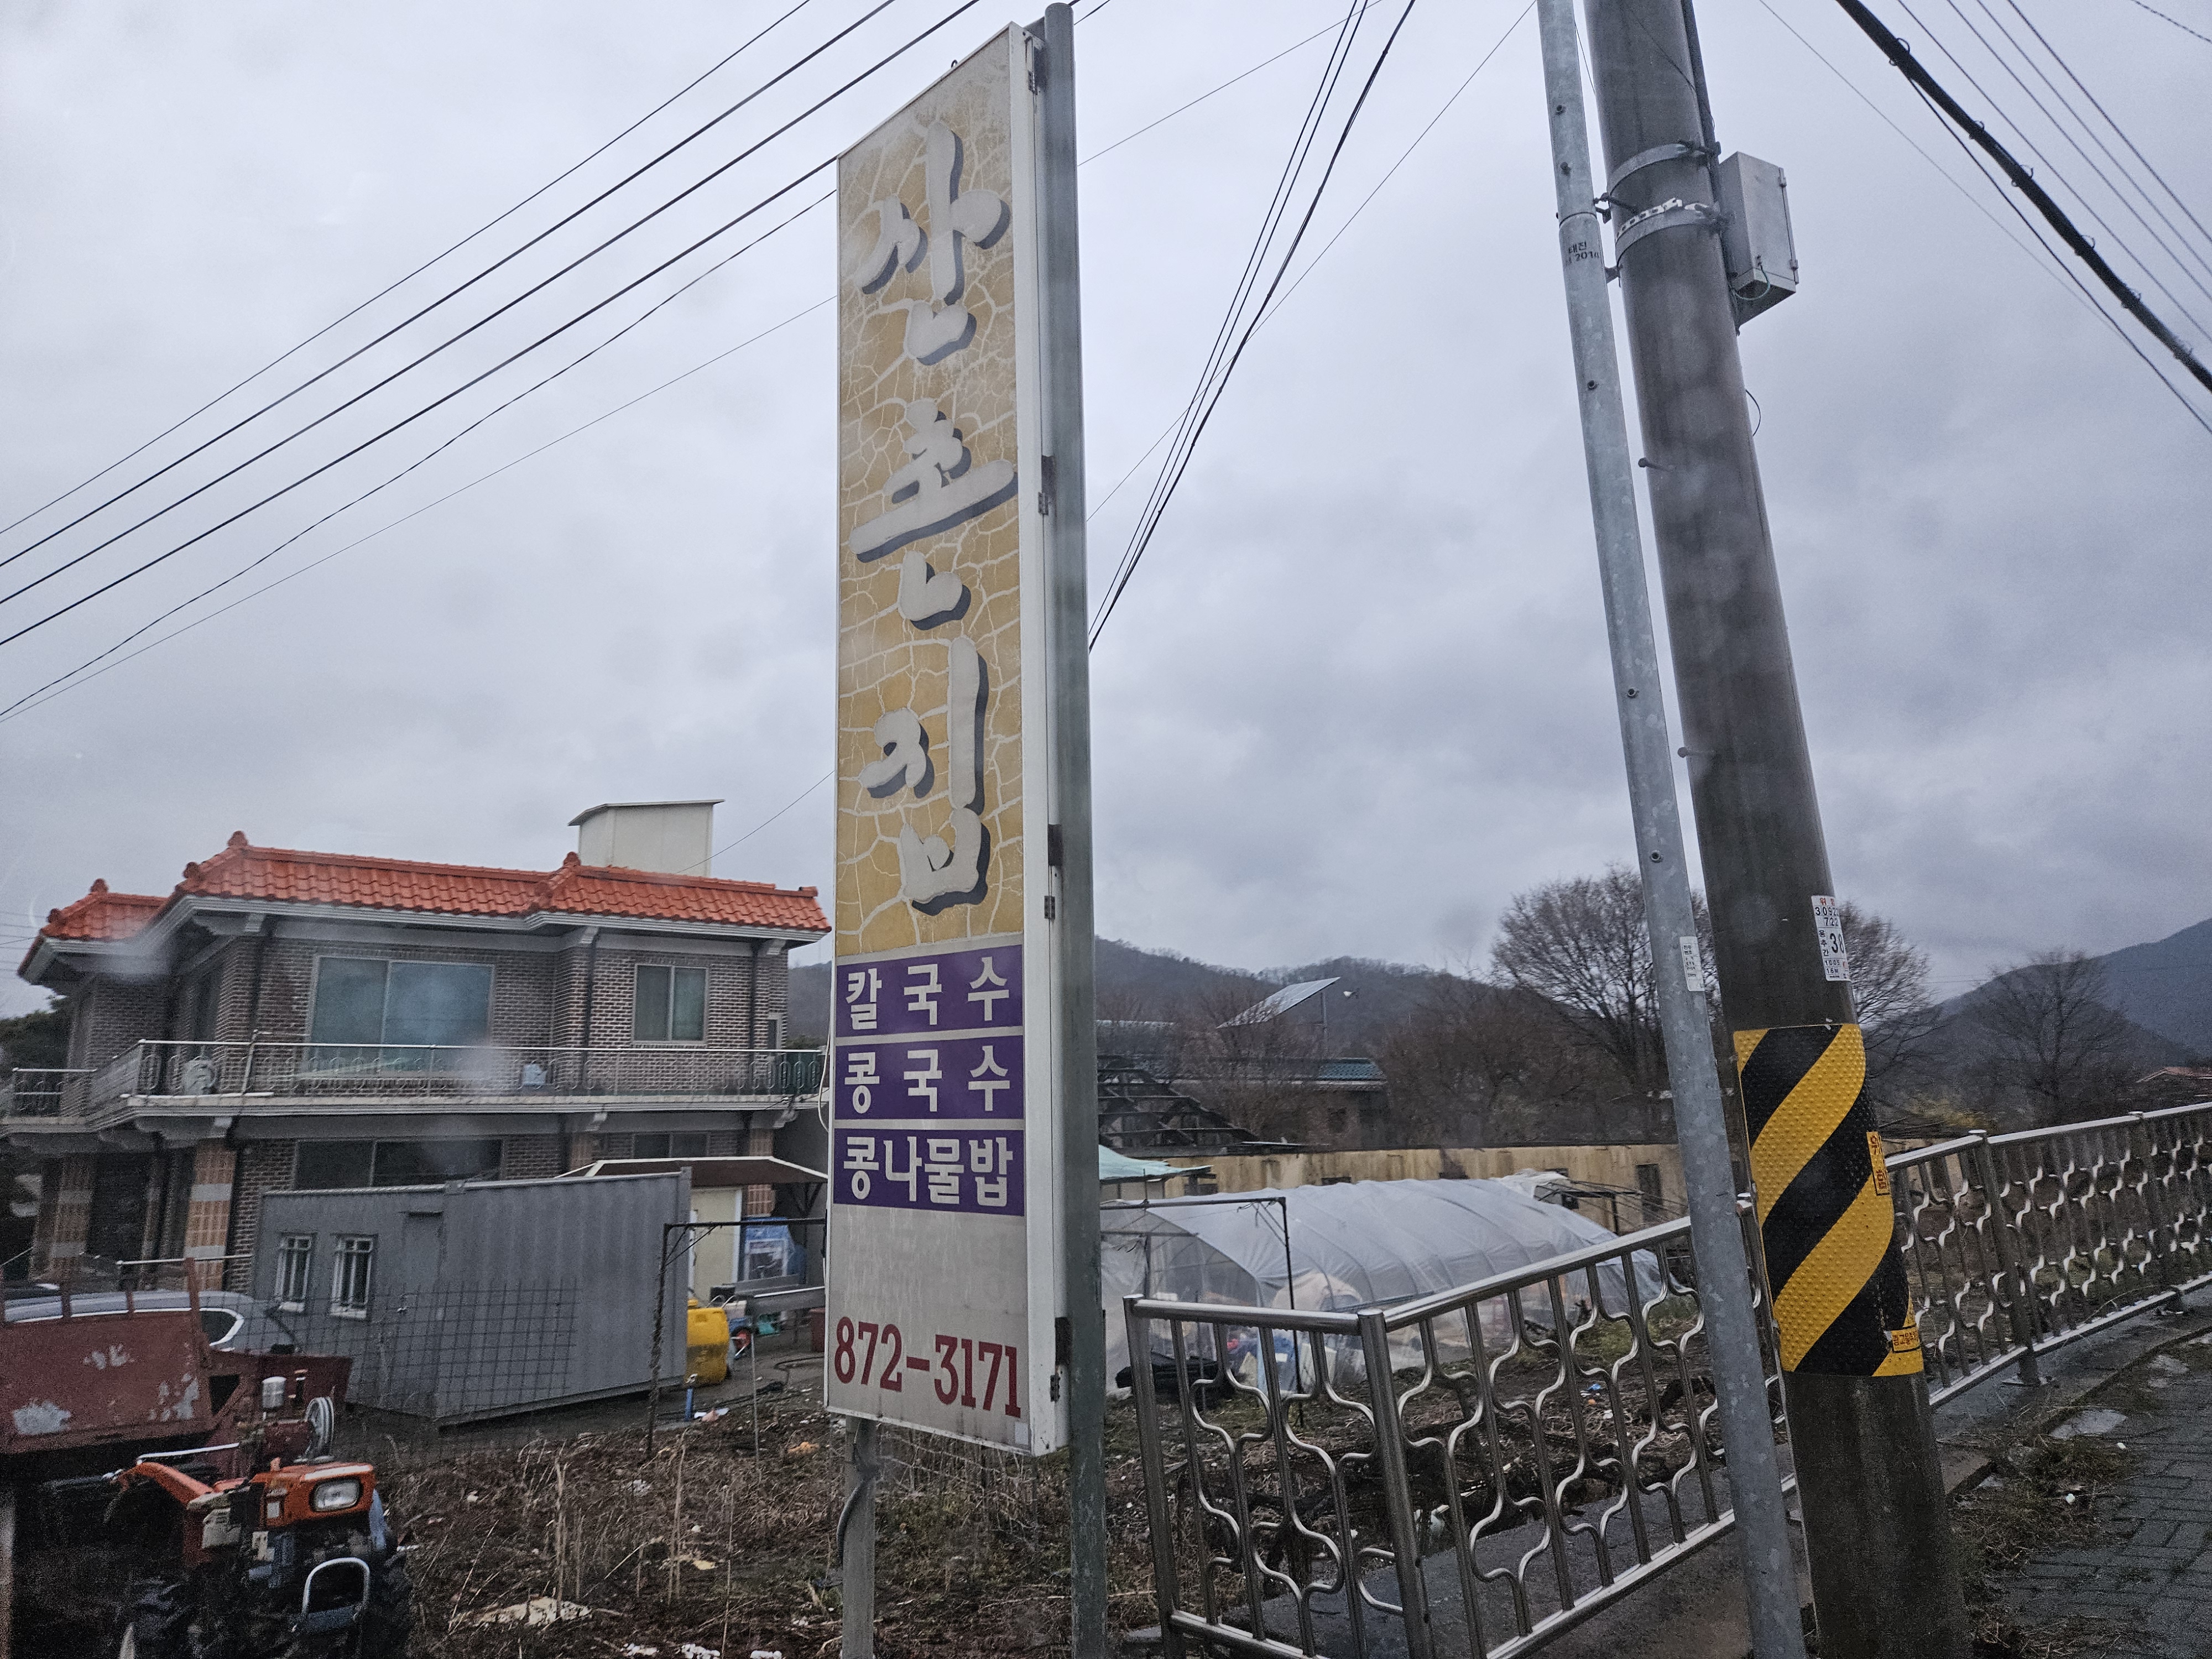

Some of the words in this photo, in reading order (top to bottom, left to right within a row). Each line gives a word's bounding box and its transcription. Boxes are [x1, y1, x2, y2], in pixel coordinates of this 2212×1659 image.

[1824, 917, 1839, 926] 722
[1830, 933, 1844, 954] 38
[843, 1136, 1013, 1207] 콩나물밥
[834, 1316, 1021, 1418] 872-3171
